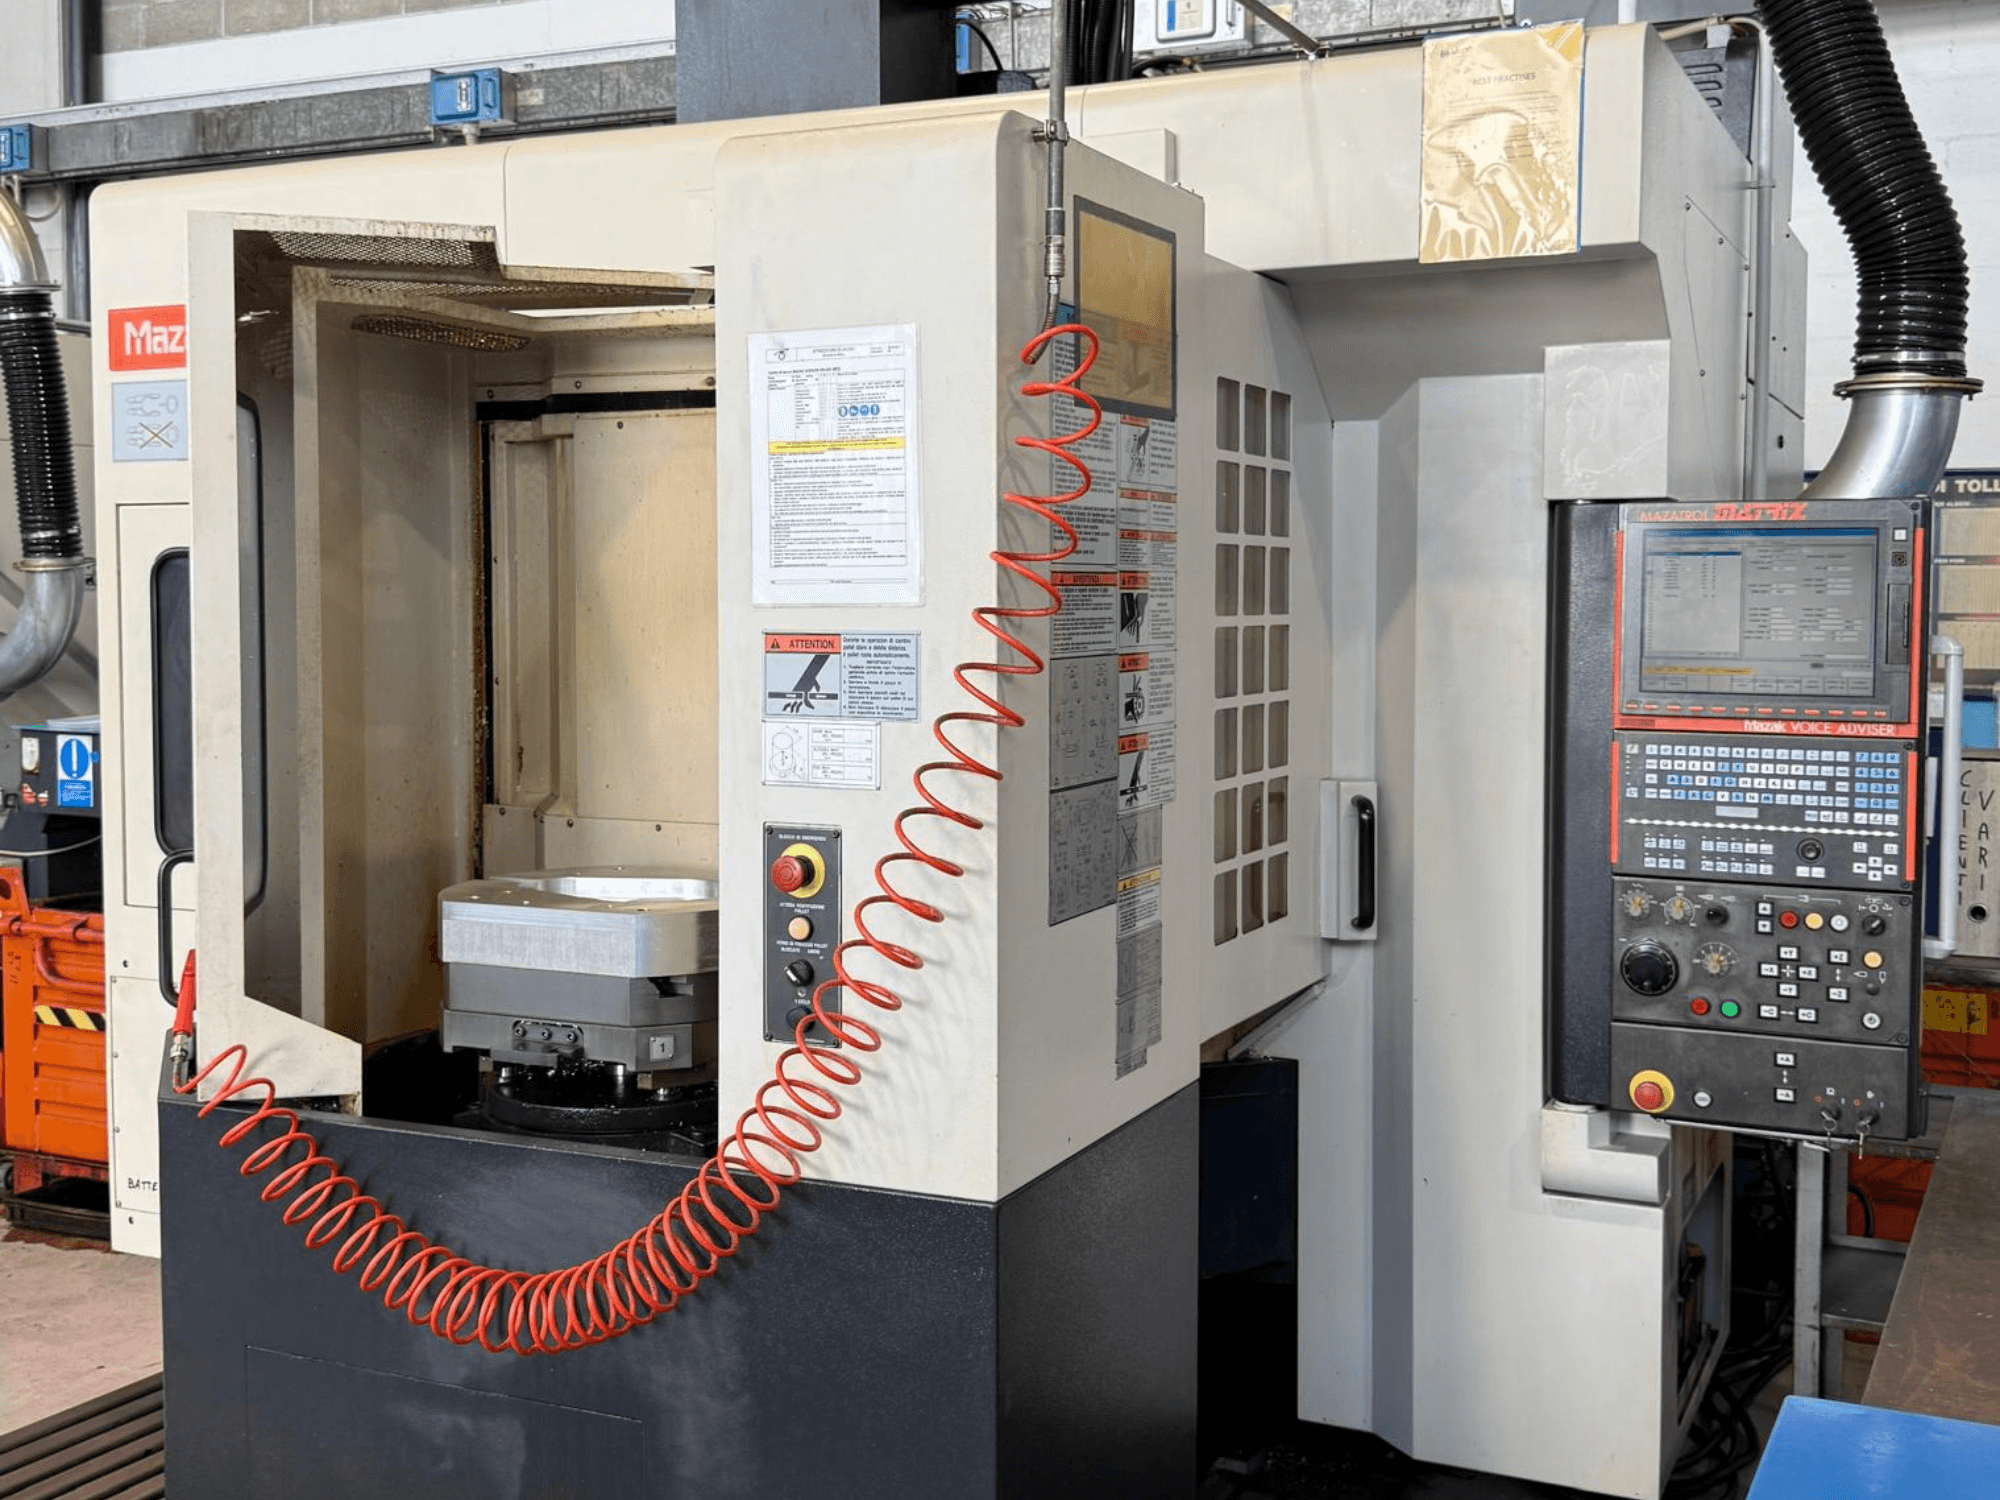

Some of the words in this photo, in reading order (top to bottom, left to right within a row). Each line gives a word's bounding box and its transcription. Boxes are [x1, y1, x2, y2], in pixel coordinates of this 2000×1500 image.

[123, 320, 185, 356] Maz
[1954, 479, 2000, 494] TOLL
[1744, 719, 1785, 733] Mazak
[1791, 721, 1832, 735] VOICE
[1837, 723, 1895, 736] ADVISER
[1978, 789, 1995, 891] VARI
[660, 1042, 665, 1053] 1
[127, 1177, 158, 1191] BATTE
